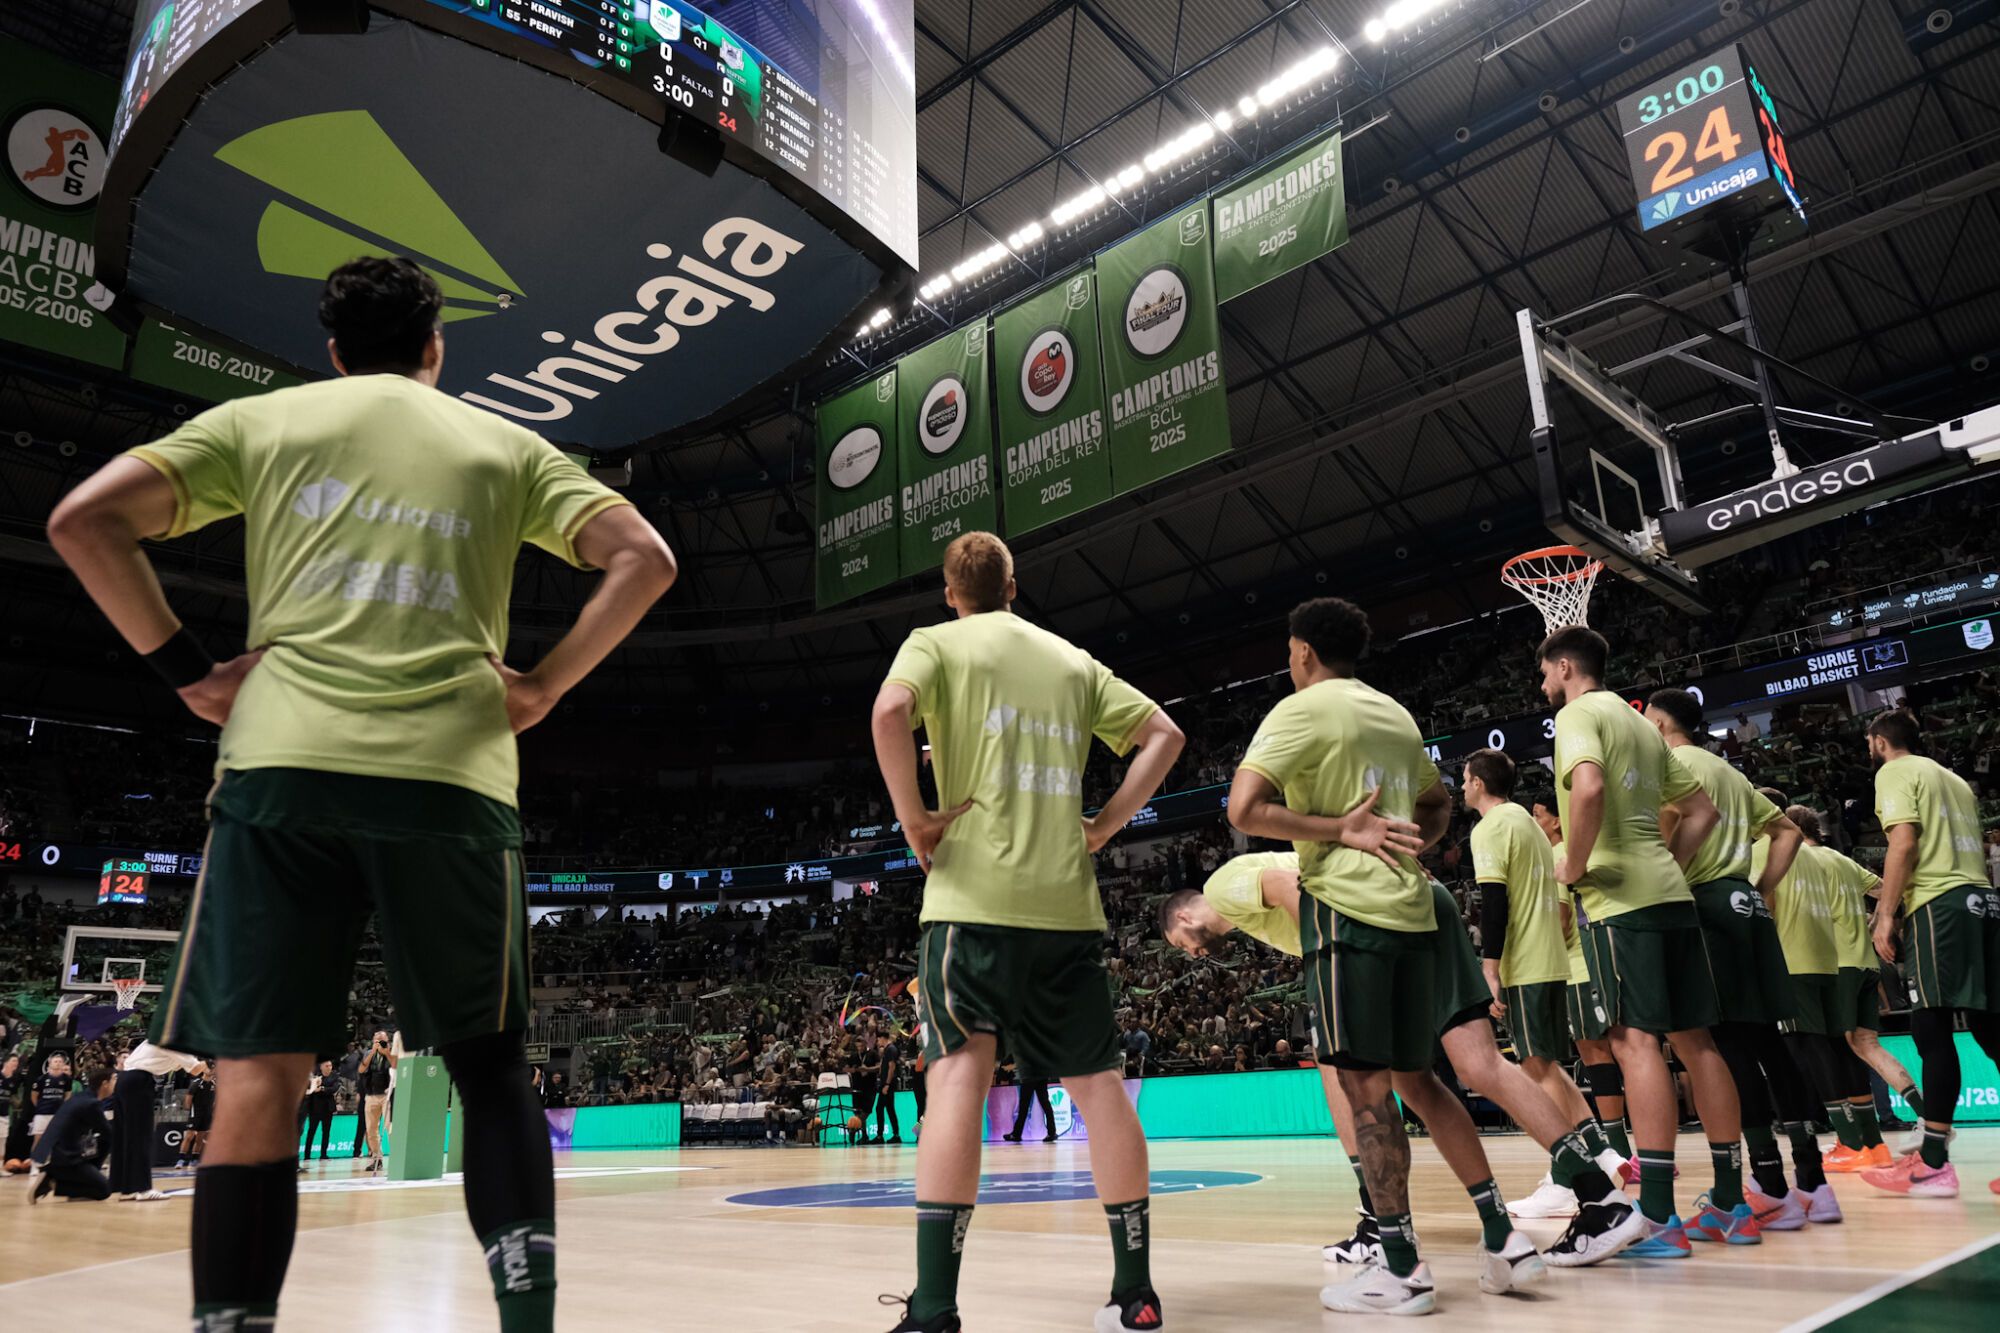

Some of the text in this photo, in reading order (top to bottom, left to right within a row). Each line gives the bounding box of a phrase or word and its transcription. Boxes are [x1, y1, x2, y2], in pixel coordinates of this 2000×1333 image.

[506, 8, 563, 39] 55 PERRY
[530, 1, 574, 29] KRAVISH
[622, 12, 629, 22] 0
[621, 27, 629, 37] 0
[620, 43, 628, 53] 0
[660, 36, 708, 62] 0 Q1
[619, 58, 627, 68] 0
[653, 75, 694, 108] 3:00
[666, 65, 729, 107] 0 FALTAS 0
[723, 77, 734, 97] 0
[1638, 65, 1725, 123] 3:00
[718, 111, 737, 133] 24
[1645, 105, 1743, 194] 24
[63, 141, 90, 197] ACB
[1219, 150, 1336, 233] CAMPEONES
[1686, 167, 1759, 205] Unicaja
[1259, 224, 1298, 257] 2025
[0, 255, 78, 301] ACB
[459, 217, 805, 421] Unicaja
[172, 341, 275, 385] 2016/2017
[1111, 350, 1219, 422] CAMPEONES
[1150, 405, 1183, 430] BCL
[1006, 409, 1103, 474] CAMPEONES
[1150, 423, 1187, 453] 2025
[1008, 438, 1104, 488] COPA DEL REY
[902, 454, 989, 512] CAMPEONES
[1040, 478, 1073, 505] 2025
[1706, 458, 1876, 531] endesa
[903, 480, 992, 528] SUPERCOPA
[819, 495, 893, 549] CAMPEONES
[931, 517, 962, 543] 2024
[842, 554, 869, 577] 2024
[1921, 582, 1969, 603] Fundación
[1923, 592, 1957, 608] Unicaja
[1807, 648, 1858, 672] SURNE
[1766, 664, 1861, 696] BILBAO BASKET
[1487, 729, 1506, 751] 0
[42, 845, 60, 866] 0
[119, 861, 147, 872] 3:00
[144, 852, 179, 865] SURNE
[115, 874, 145, 894] 24
[551, 873, 587, 884] UNICAJA
[551, 883, 581, 893] BILBAO
[582, 883, 615, 893] BASKET
